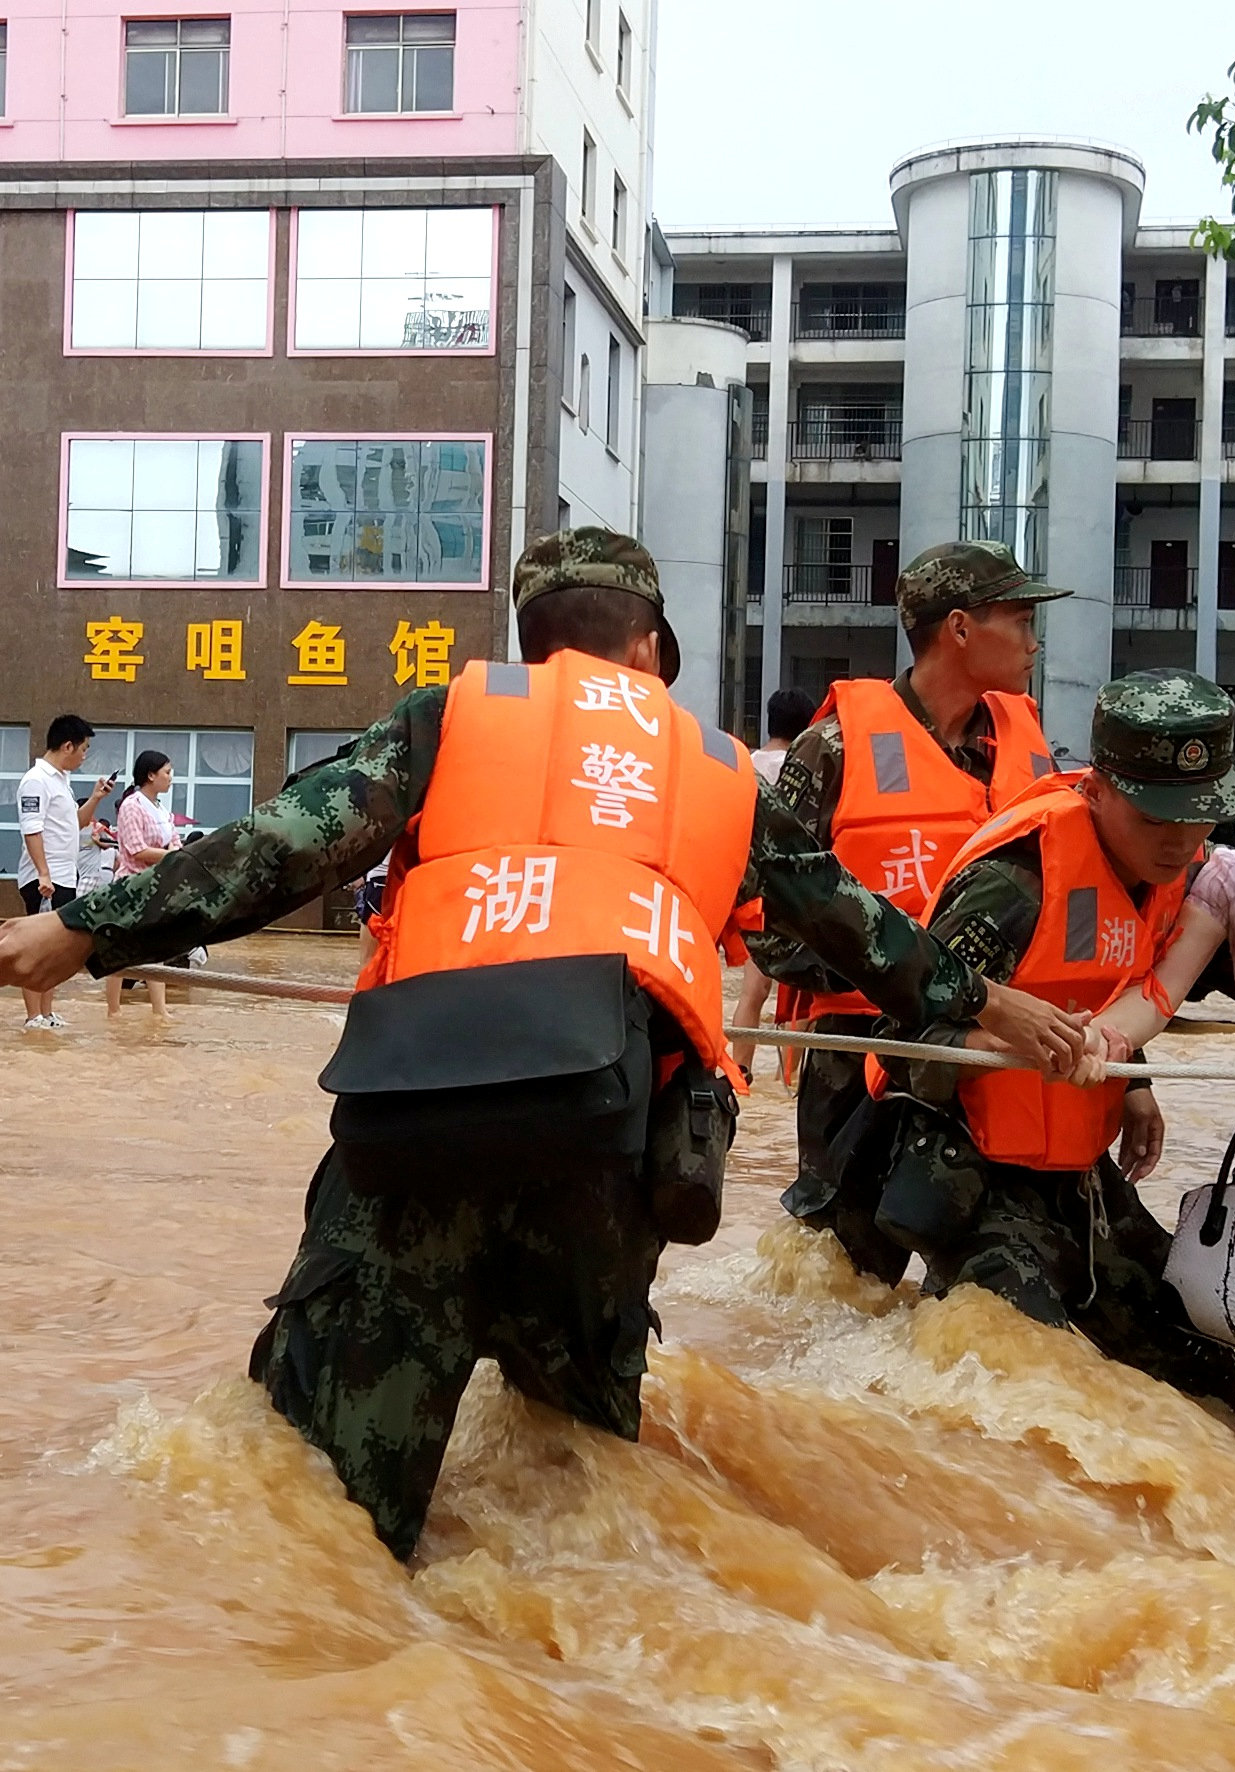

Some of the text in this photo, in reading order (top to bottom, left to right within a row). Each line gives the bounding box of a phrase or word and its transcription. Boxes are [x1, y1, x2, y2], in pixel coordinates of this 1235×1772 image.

[84, 616, 454, 687] 窑咀鱼馆
[570, 672, 658, 828] 武警
[880, 829, 940, 900] 武
[461, 856, 695, 983] 湖北
[1101, 917, 1135, 967] 湖
